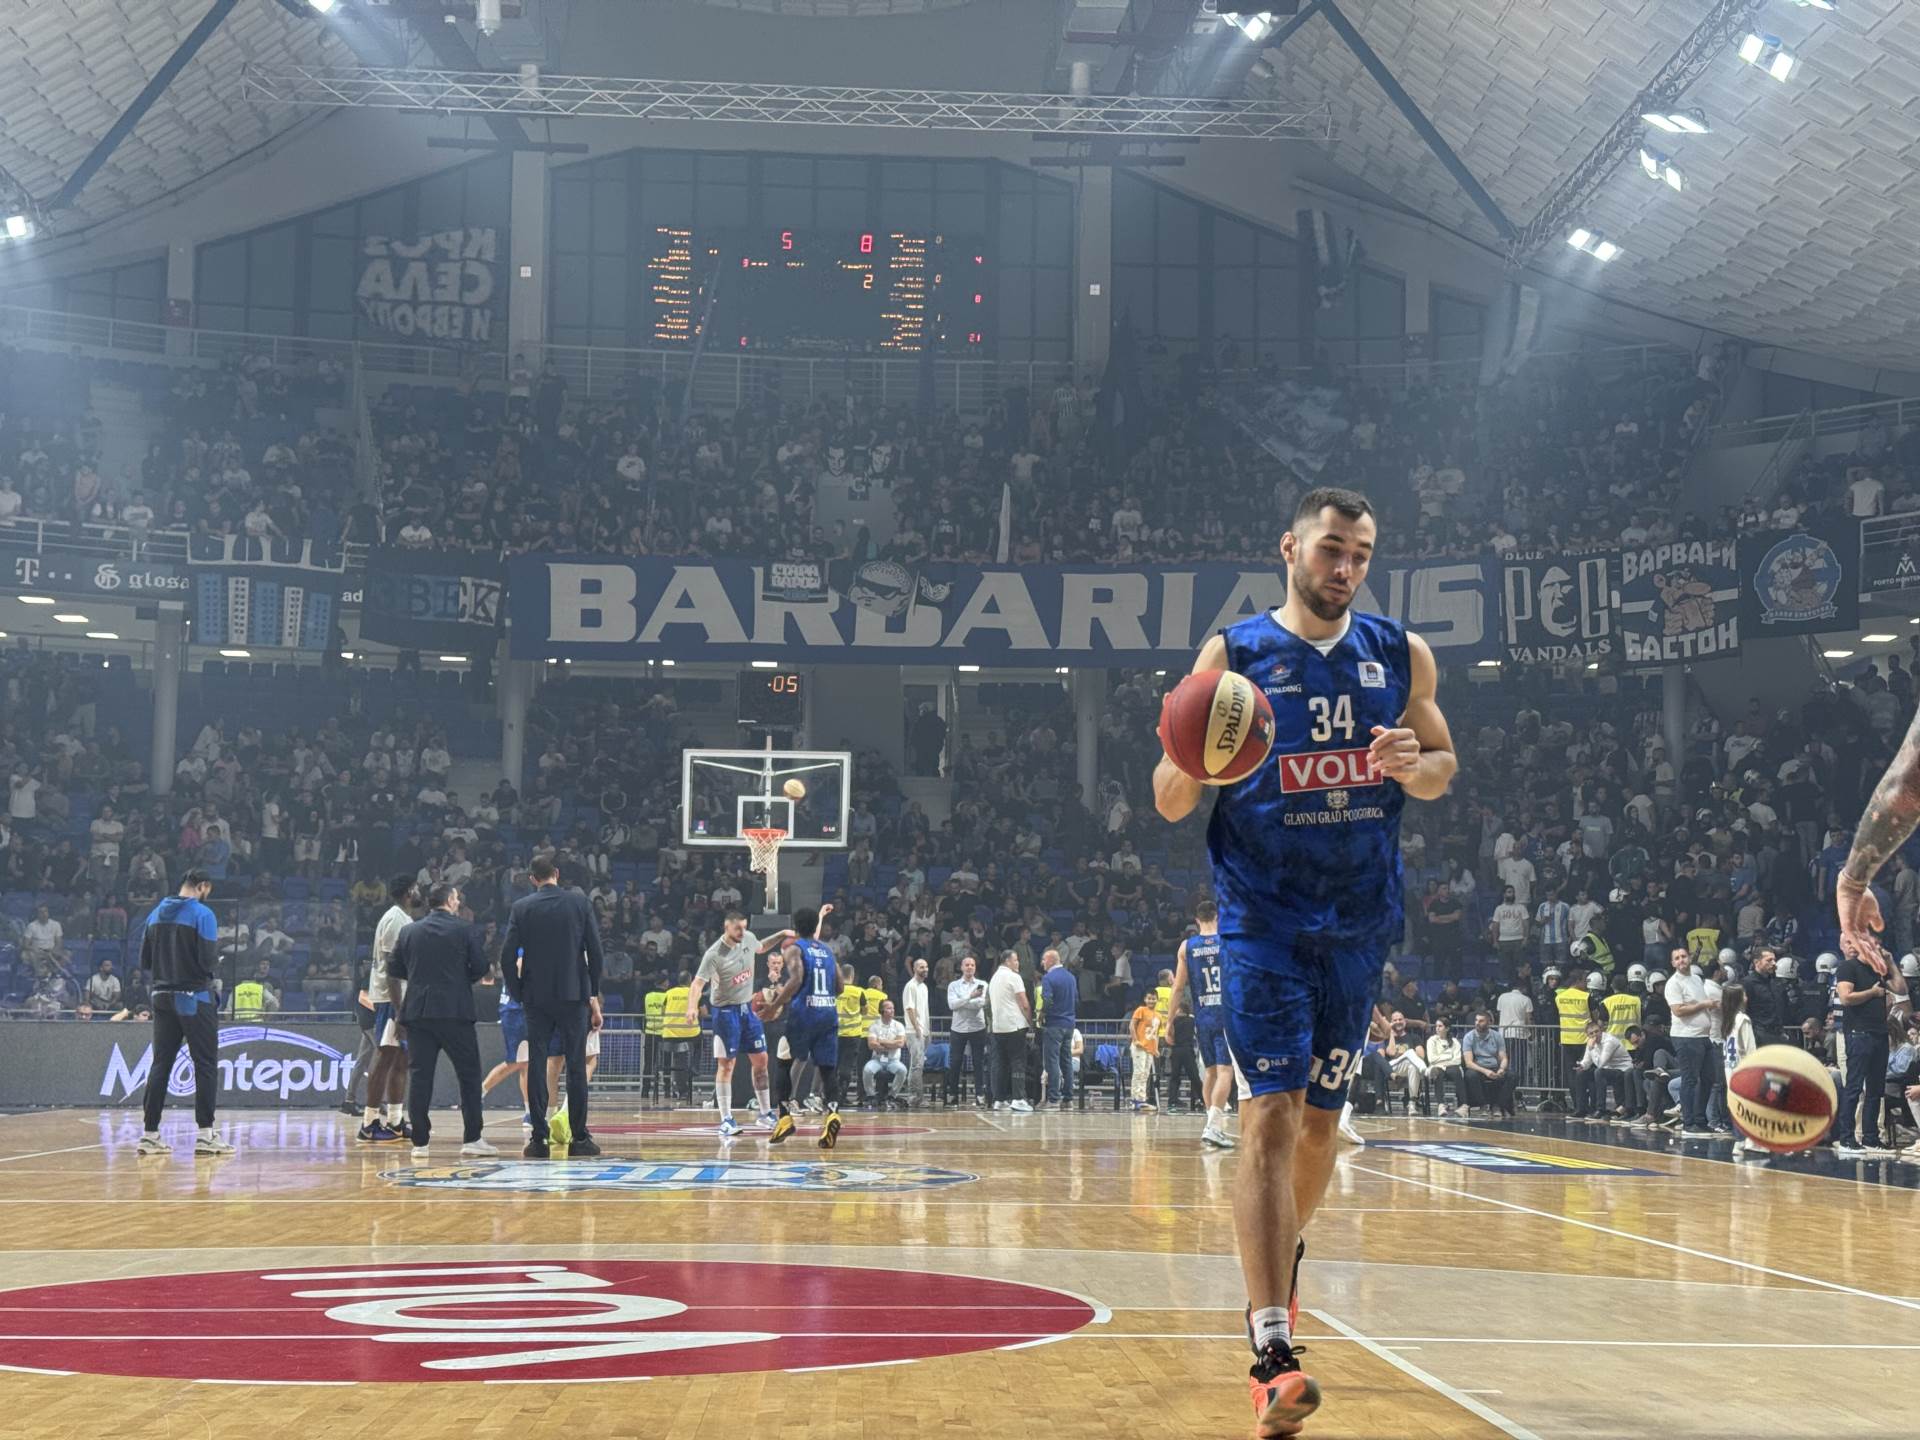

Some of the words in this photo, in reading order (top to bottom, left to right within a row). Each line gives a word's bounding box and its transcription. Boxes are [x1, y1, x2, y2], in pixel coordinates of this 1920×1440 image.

[782, 232, 793, 250] 5
[860, 234, 873, 253] 8
[863, 274, 874, 289] 2
[1624, 616, 1738, 661] БАСТОН
[1508, 639, 1612, 662] VANDALS
[1264, 683, 1302, 696] SPALDING
[1308, 694, 1356, 743] 34
[1284, 811, 1316, 826] GLAVNI
[1318, 810, 1342, 825] GRAD
[813, 967, 829, 995] 11
[1201, 966, 1222, 993] 13
[1736, 1100, 1808, 1136] SPALDING
